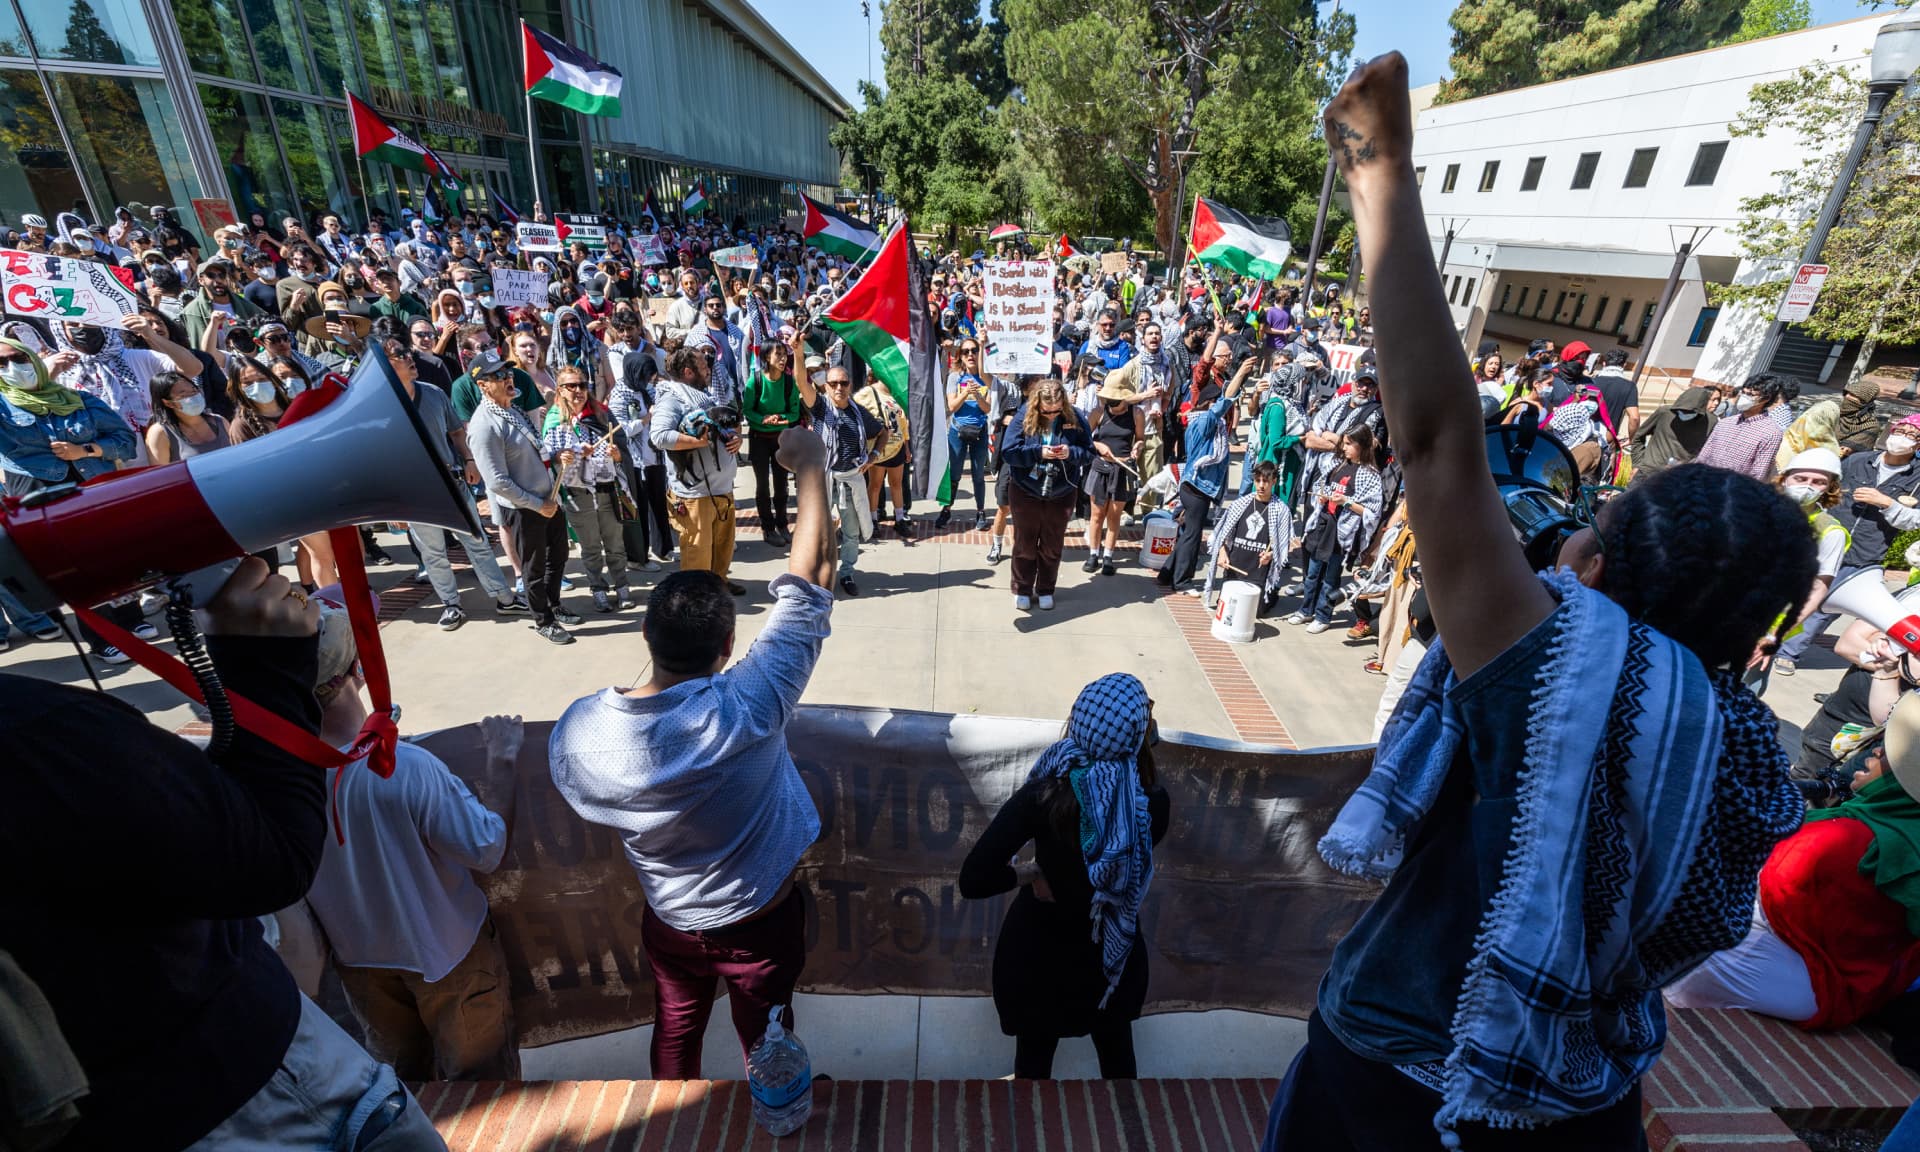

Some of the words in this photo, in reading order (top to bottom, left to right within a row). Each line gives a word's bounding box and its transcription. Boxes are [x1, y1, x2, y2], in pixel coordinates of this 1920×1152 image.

[570, 215, 580, 223] NO
[580, 215, 592, 224] TAX
[520, 227, 555, 237] CEASEFIRE
[530, 236, 549, 245] NOW
[0, 251, 77, 281] FREE
[984, 265, 996, 276] To
[999, 265, 1025, 278] Stand
[1796, 274, 1809, 284] NO
[509, 281, 530, 289] PARA
[992, 282, 1037, 297] Palestine
[497, 289, 548, 304] PALESTINA
[989, 302, 998, 315] is
[1002, 302, 1014, 315] to
[1017, 302, 1045, 315] Stand
[1247, 540, 1267, 549] GAZA
